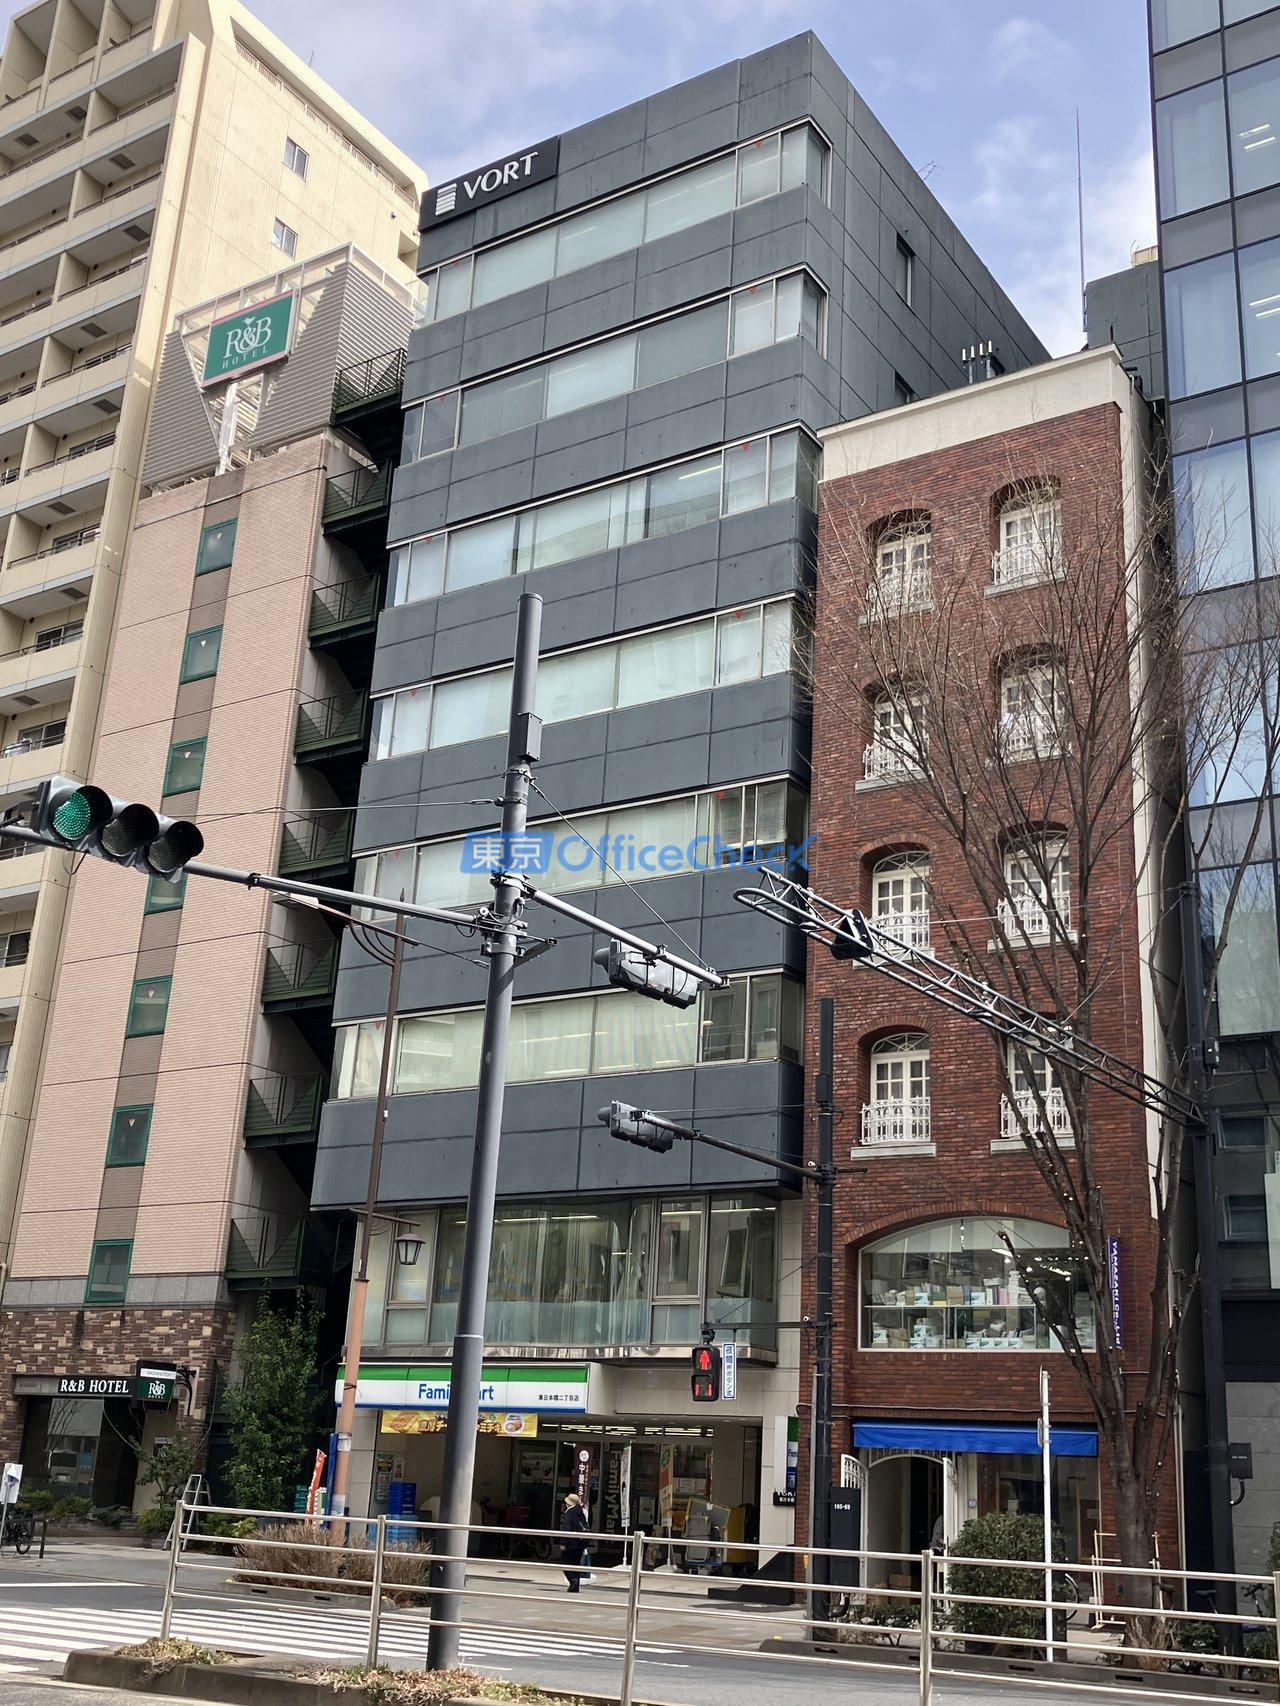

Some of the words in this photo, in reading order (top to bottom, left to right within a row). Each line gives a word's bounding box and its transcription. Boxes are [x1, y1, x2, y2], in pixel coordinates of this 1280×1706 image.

[463, 151, 539, 199] VORT
[222, 316, 271, 359] R&B
[222, 346, 268, 369] HOTEL
[60, 1379, 85, 1393] R&B
[89, 1379, 129, 1394] HOTEL
[148, 1381, 166, 1396] R&B
[605, 1450, 621, 1542] FamilyMar
